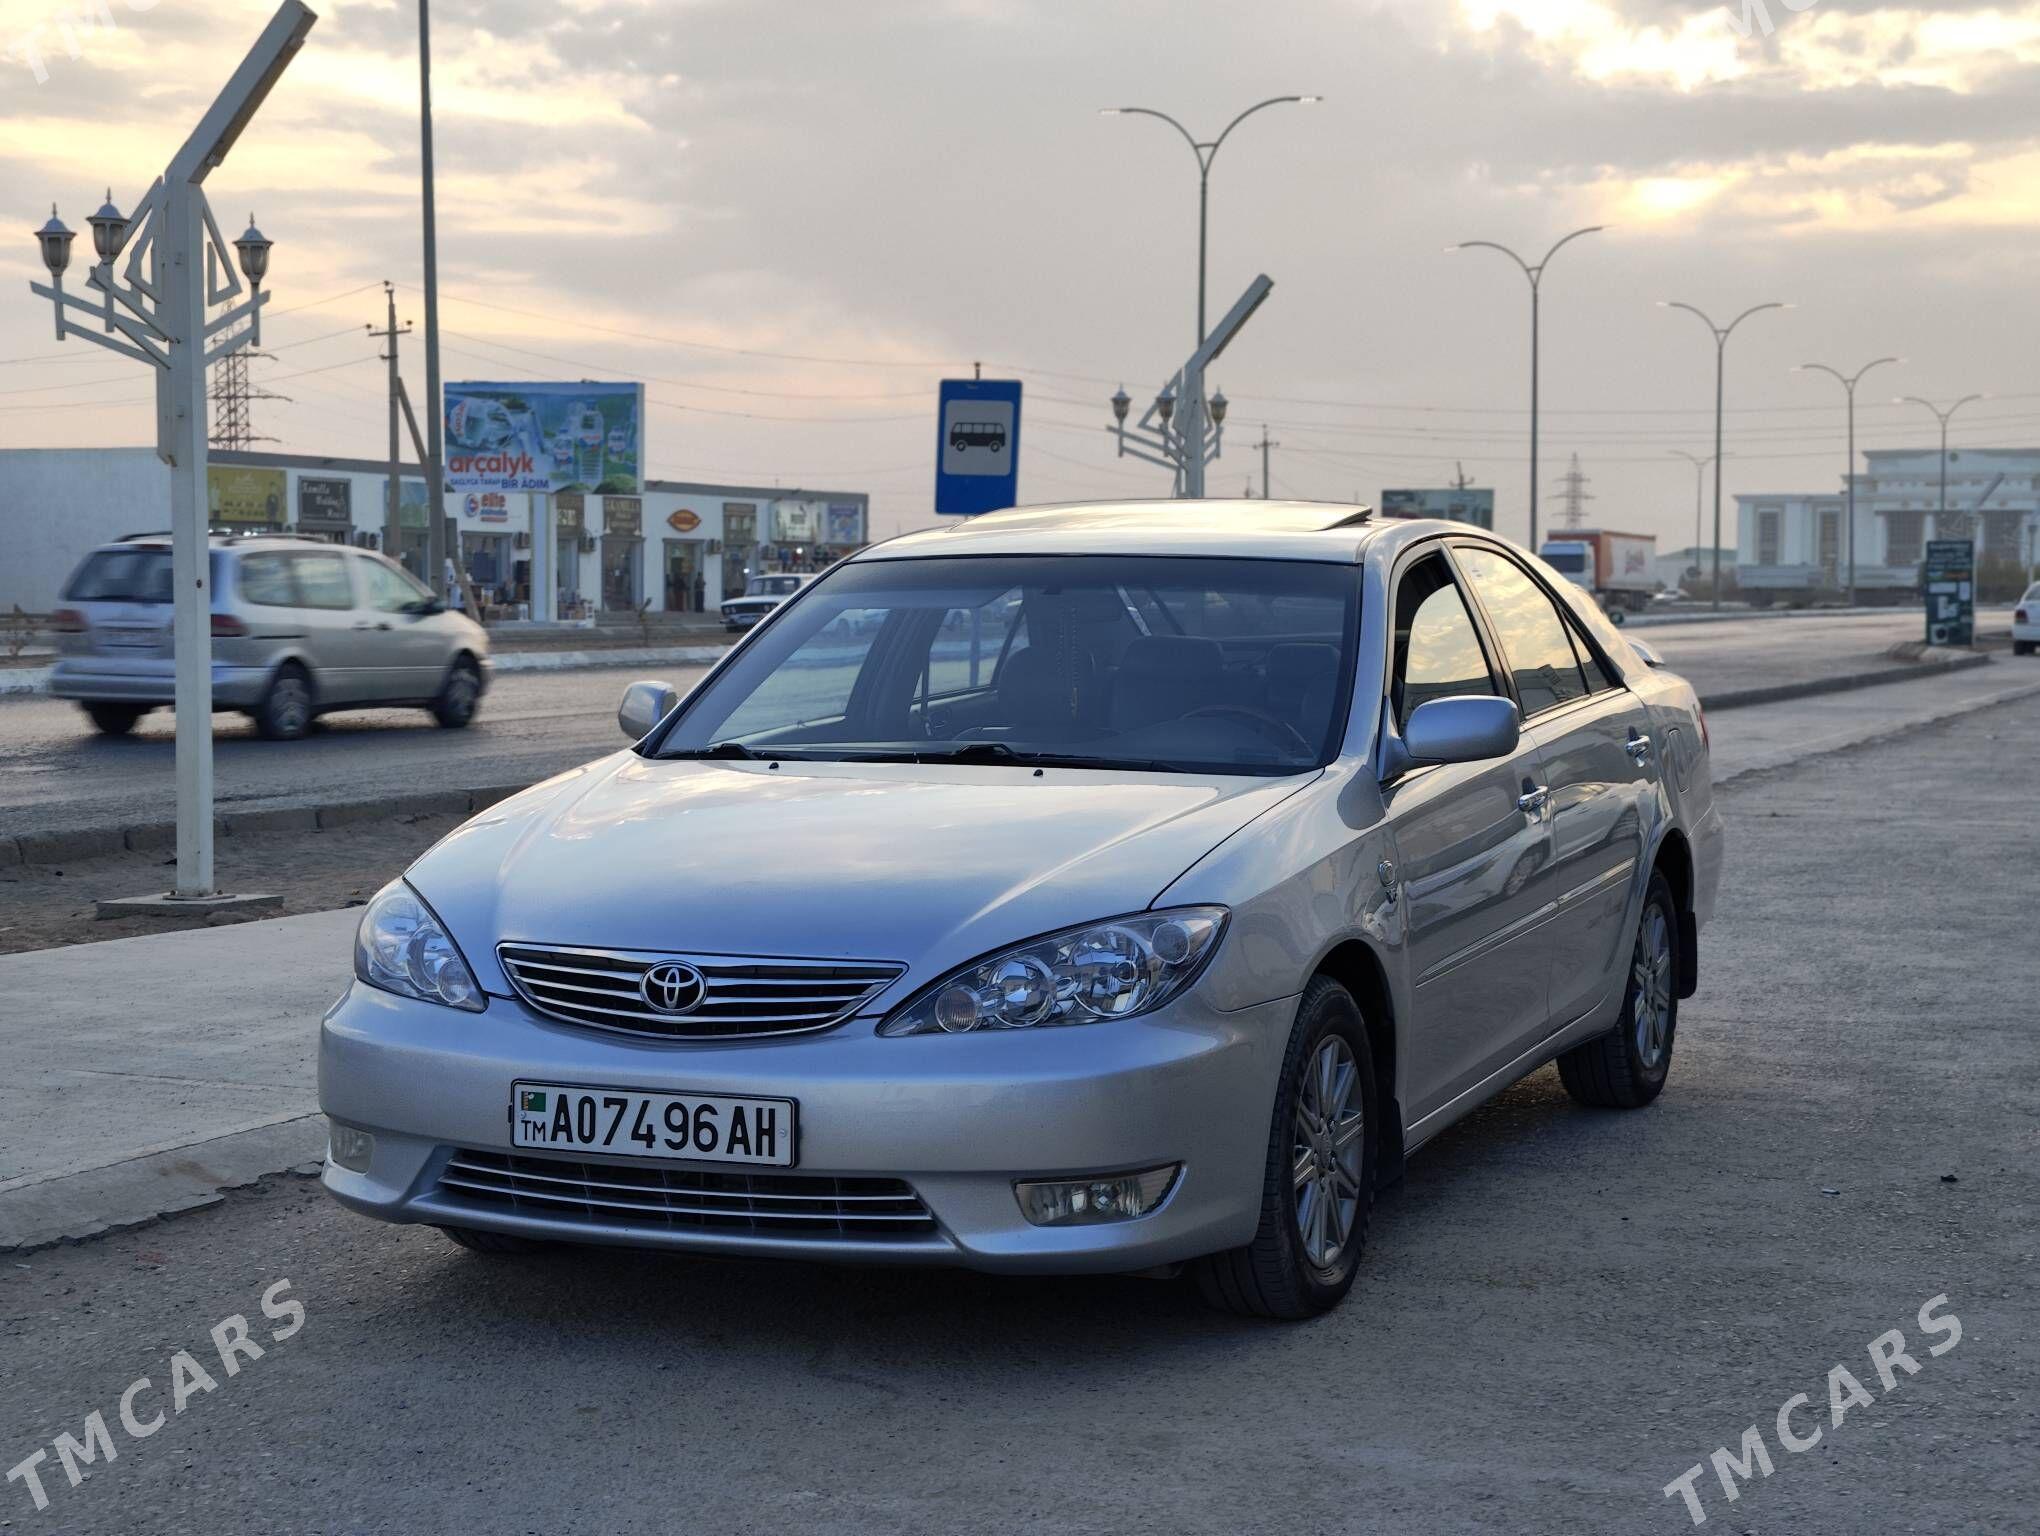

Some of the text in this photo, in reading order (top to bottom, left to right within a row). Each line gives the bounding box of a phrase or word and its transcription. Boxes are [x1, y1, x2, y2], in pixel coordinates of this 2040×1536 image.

[449, 451, 534, 478] arçalyk
[520, 1093, 777, 1158] TM A07496AH
